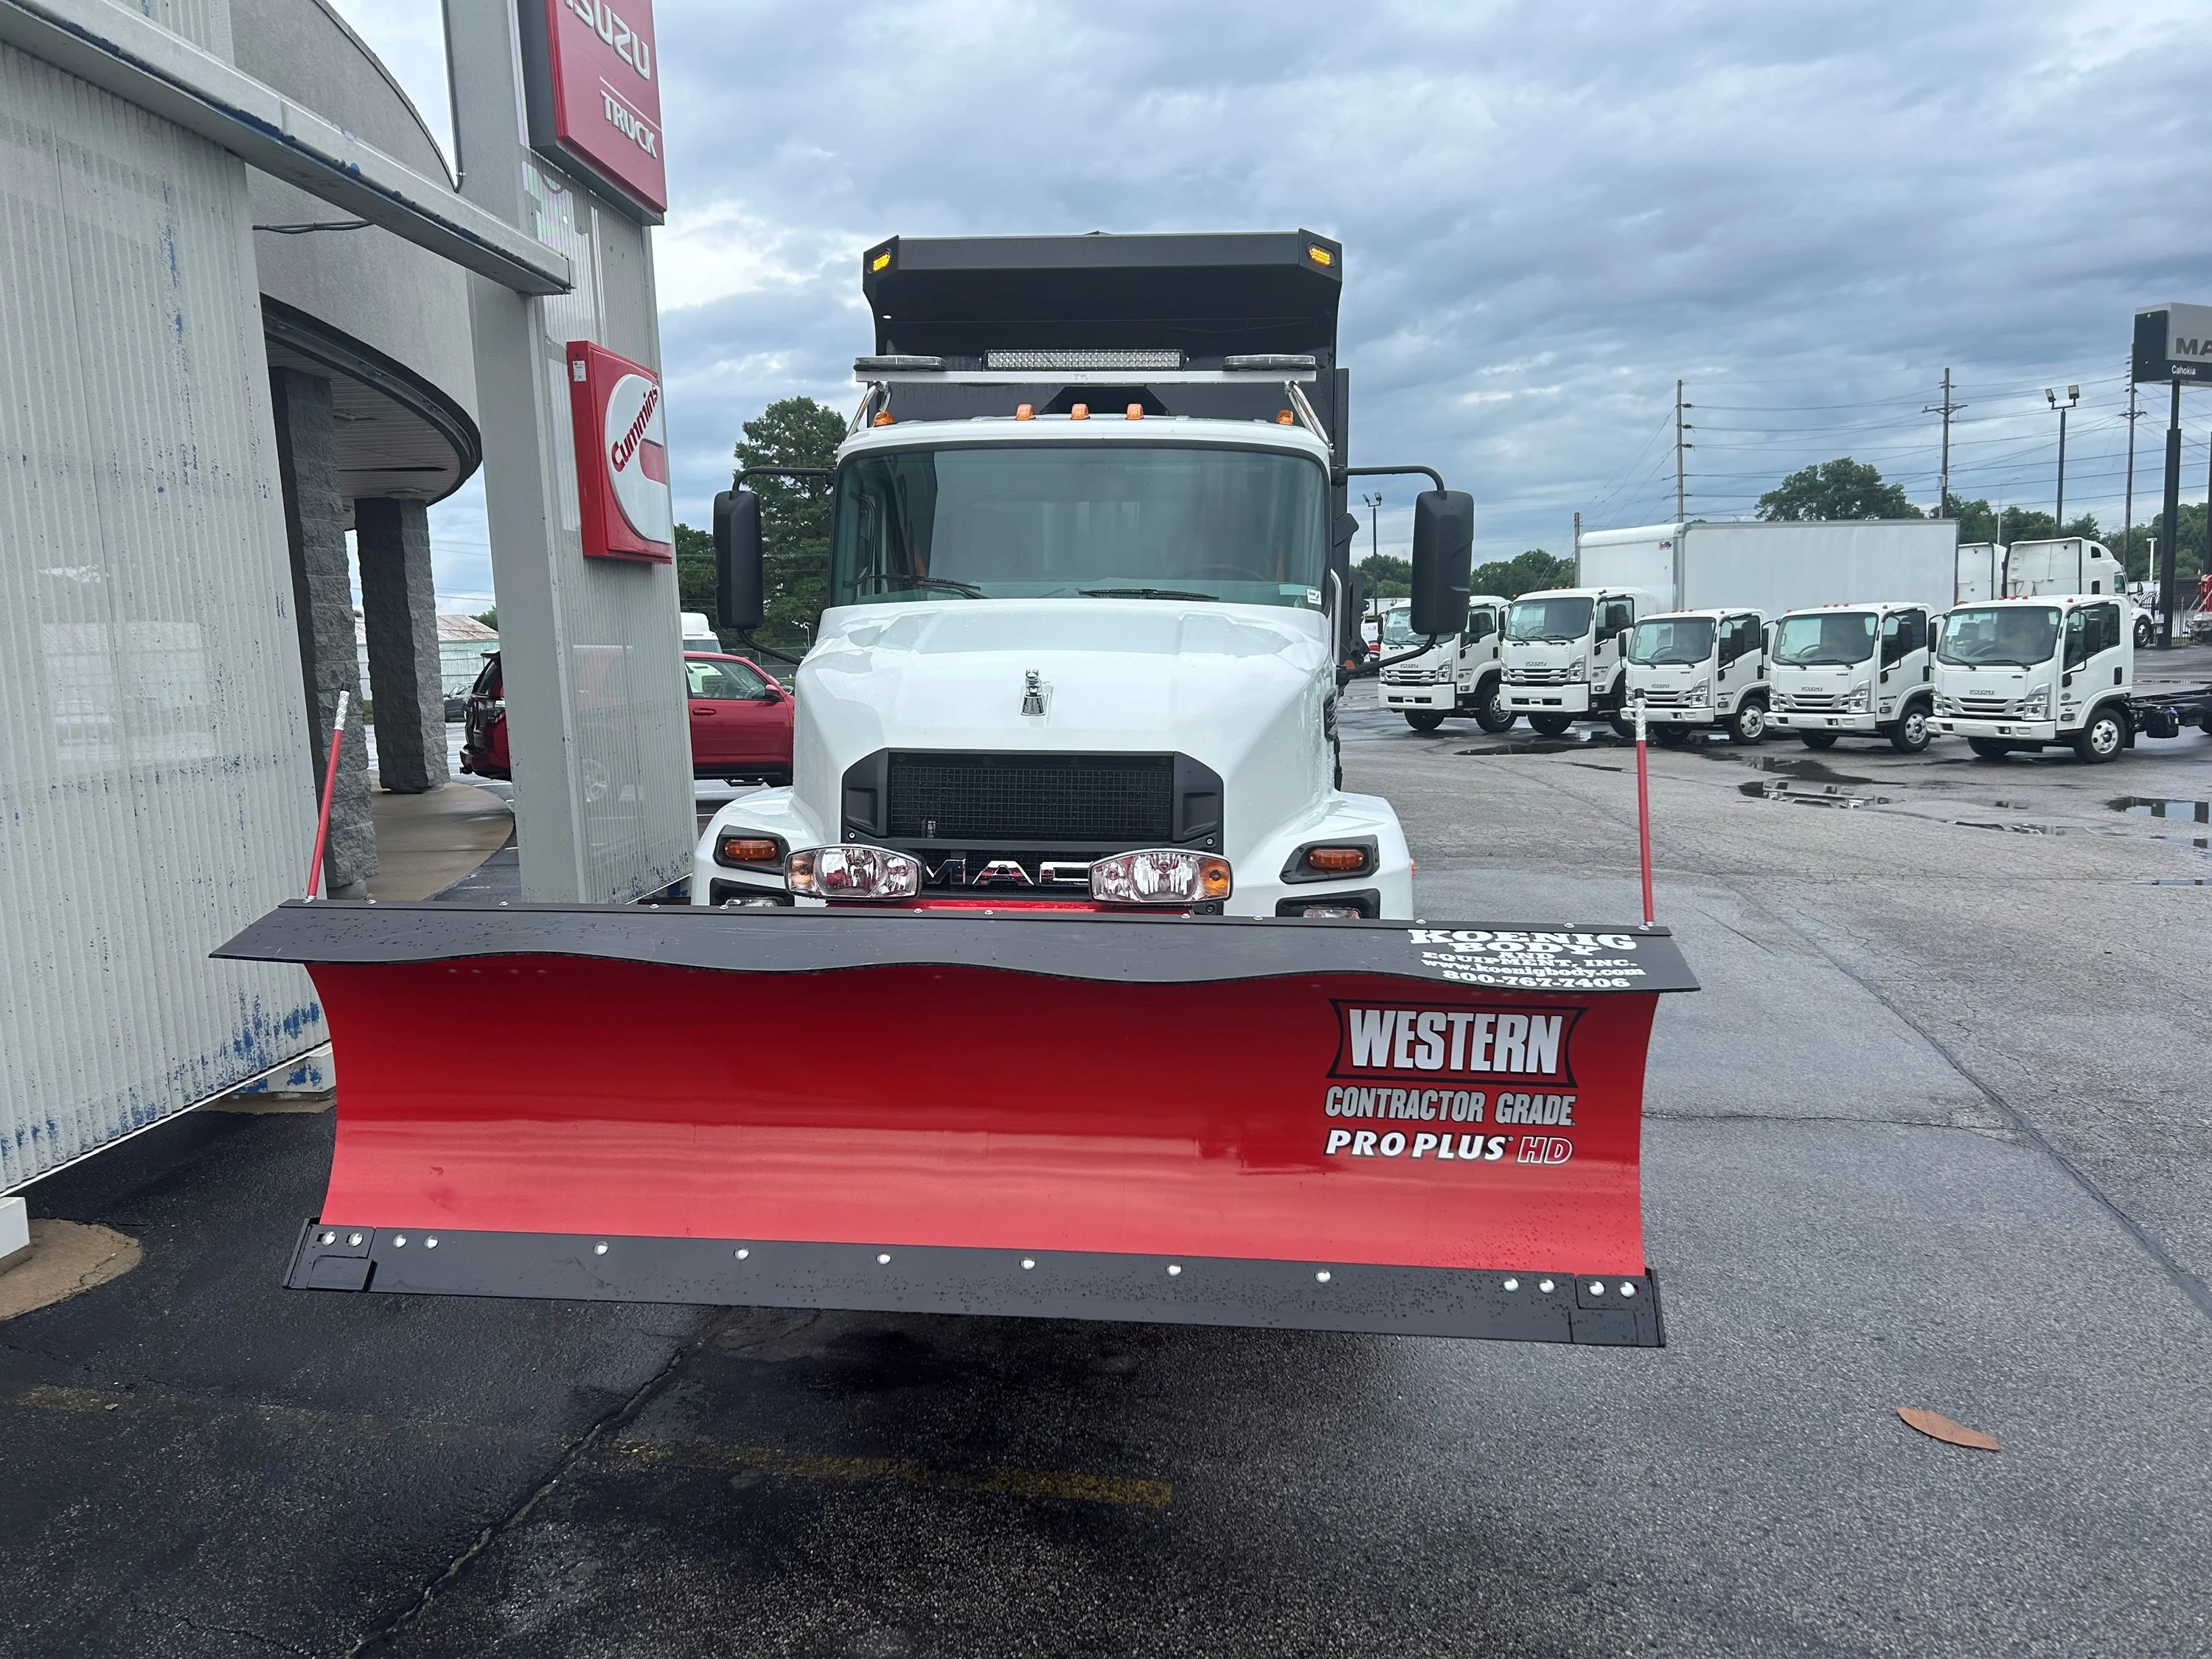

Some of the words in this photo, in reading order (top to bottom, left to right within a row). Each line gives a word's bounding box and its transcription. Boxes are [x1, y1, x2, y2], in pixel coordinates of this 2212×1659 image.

[565, 0, 650, 80] SUZU
[600, 89, 657, 159] TRUCK
[2171, 365, 2196, 375] Cahokia
[611, 388, 658, 473] Cummins
[1408, 929, 1637, 950] KOENIG
[1448, 942, 1602, 956] BODY
[1422, 951, 1578, 967] EQUIPMENT,
[1583, 959, 1638, 967] INC.
[1498, 951, 1555, 959] AND
[1421, 959, 1646, 978] www.koenigbody.com
[1442, 970, 1631, 988] 800-767-7406
[1349, 1008, 1563, 1074] WESTERN
[1325, 1085, 1486, 1123] CONTRACTOR
[1495, 1093, 1576, 1127] GRADE
[1517, 1135, 1574, 1164] HD
